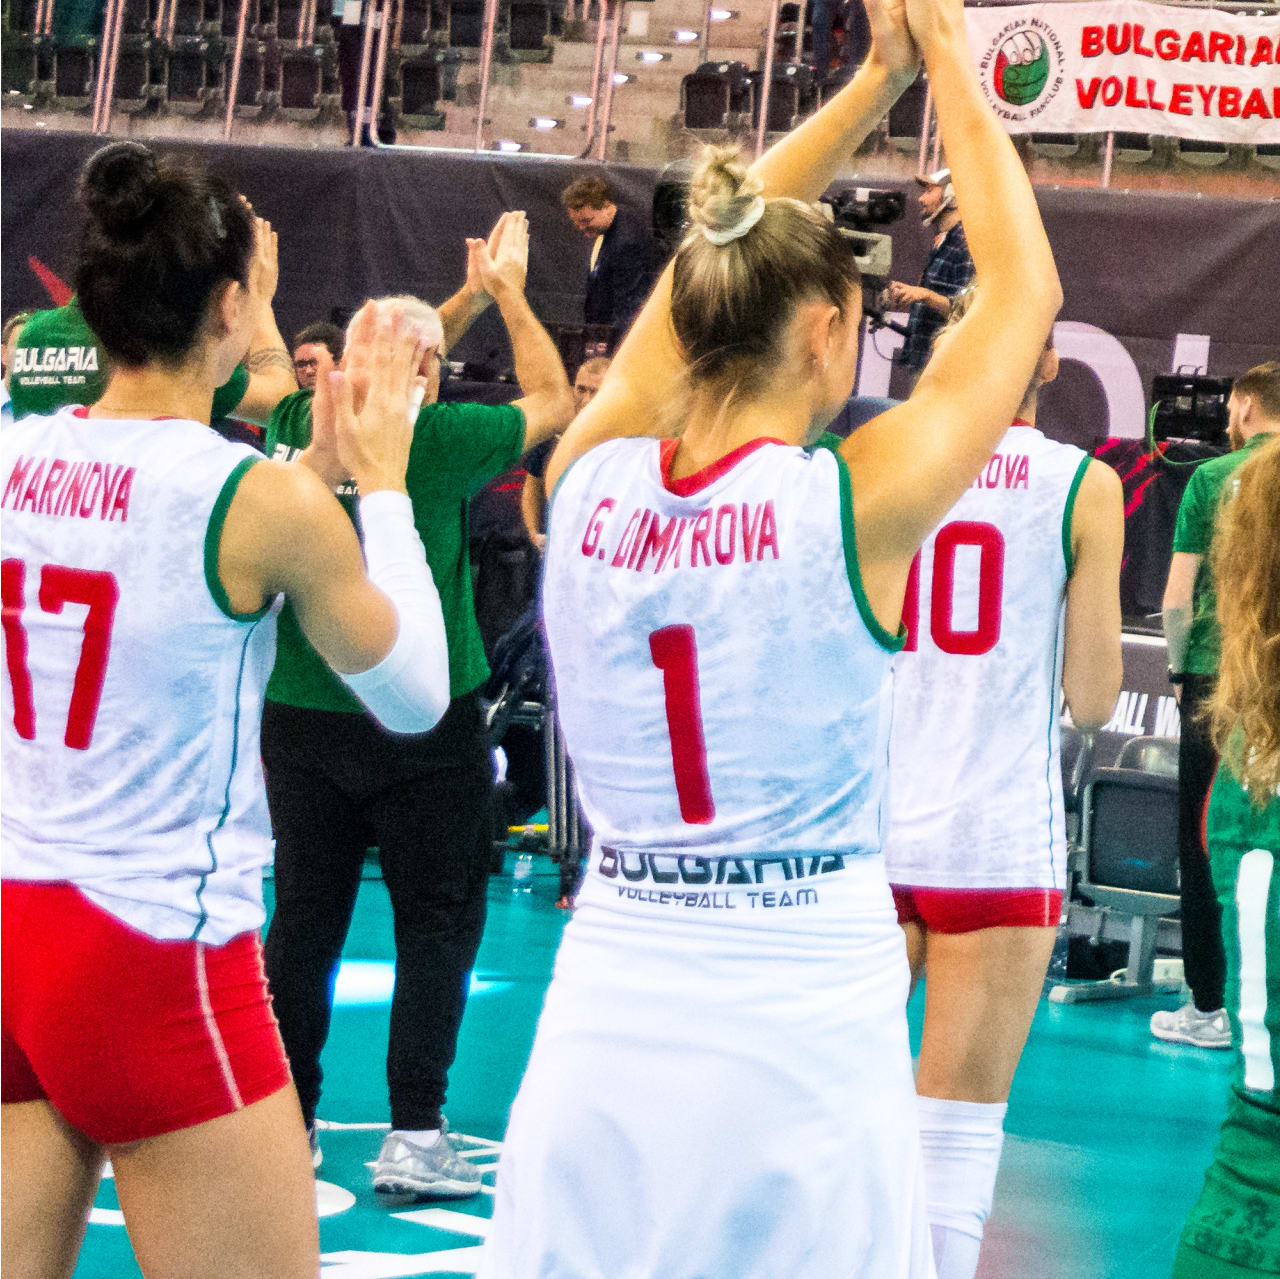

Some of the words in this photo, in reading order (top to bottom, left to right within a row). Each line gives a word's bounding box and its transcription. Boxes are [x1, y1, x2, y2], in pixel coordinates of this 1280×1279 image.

[13, 346, 99, 373] BULGARIA
[62, 376, 86, 385] TEAM
[1, 454, 137, 521] MARINOVA
[581, 497, 617, 561] G.
[1, 557, 121, 751] 17
[648, 623, 717, 826] 1
[747, 887, 820, 909] TEAM
